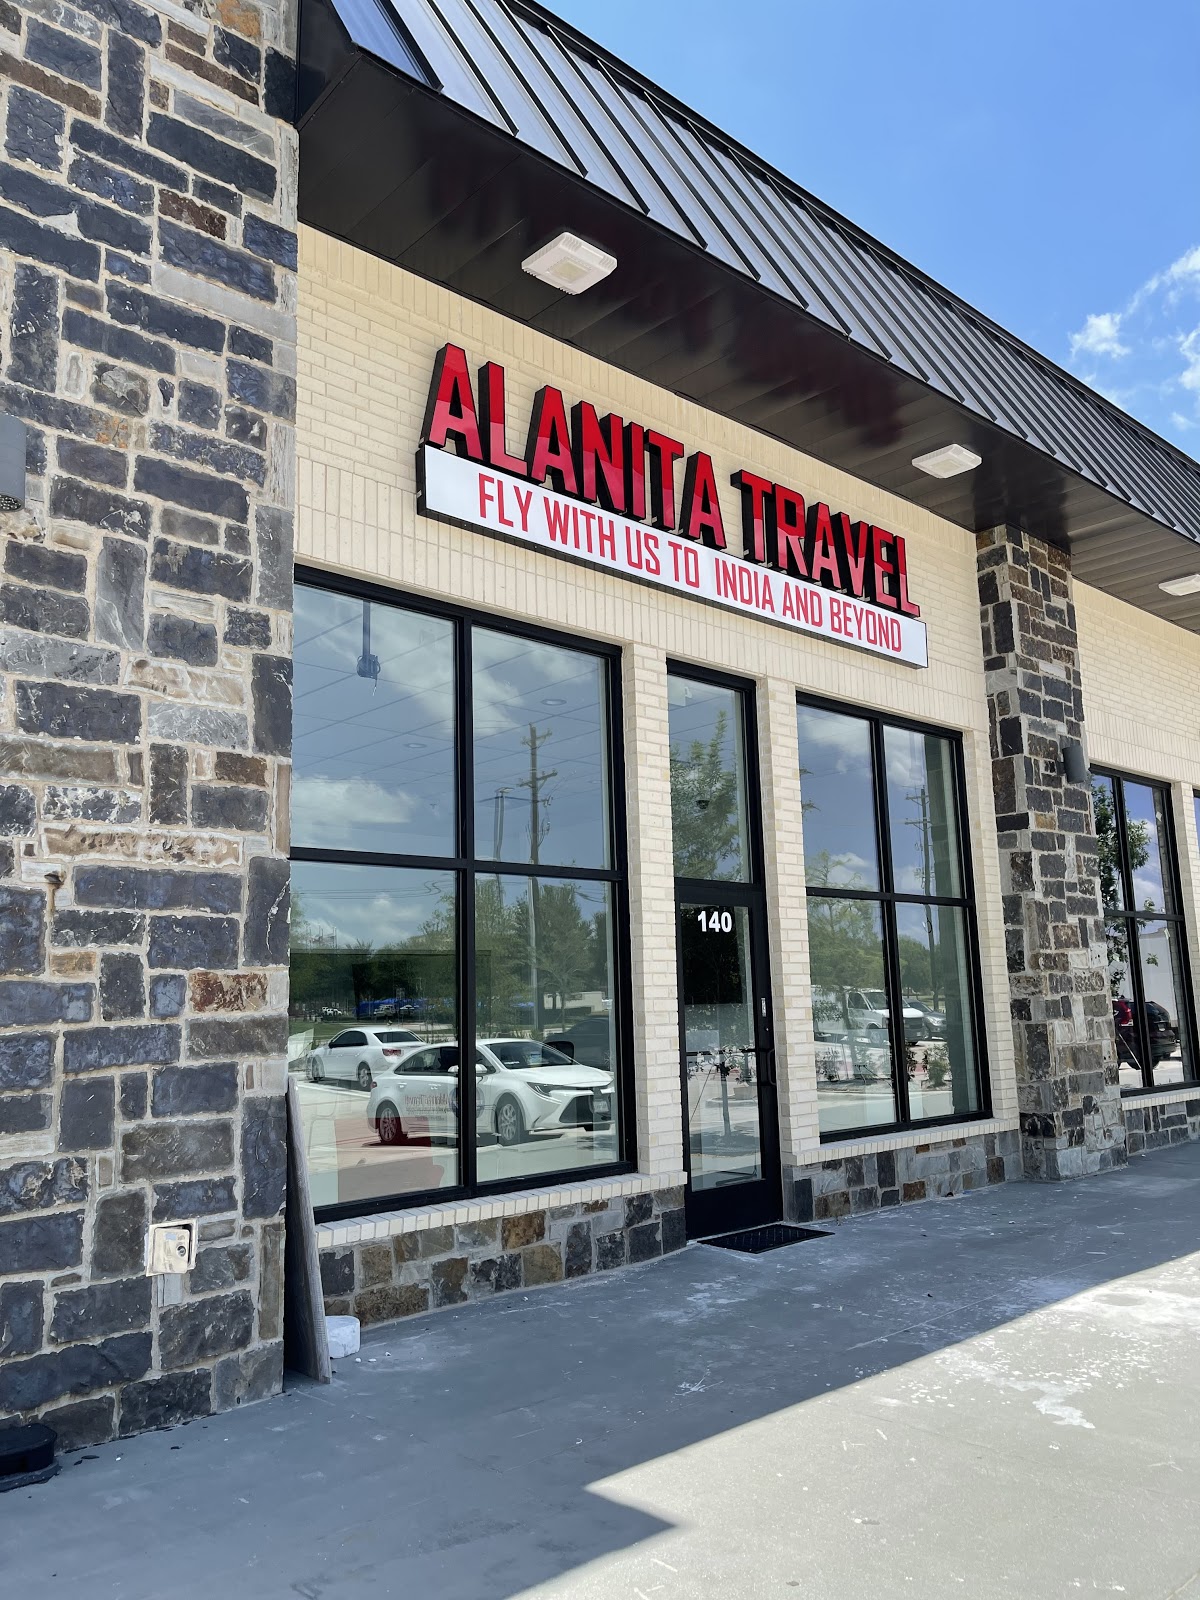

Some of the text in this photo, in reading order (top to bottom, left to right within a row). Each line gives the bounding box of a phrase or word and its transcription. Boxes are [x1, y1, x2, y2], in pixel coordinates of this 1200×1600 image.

[421, 343, 921, 617] ALANITA TRAVEL
[478, 472, 902, 653] FLY WITH US TO INDIA AND BEYOND
[697, 910, 732, 933] 140
